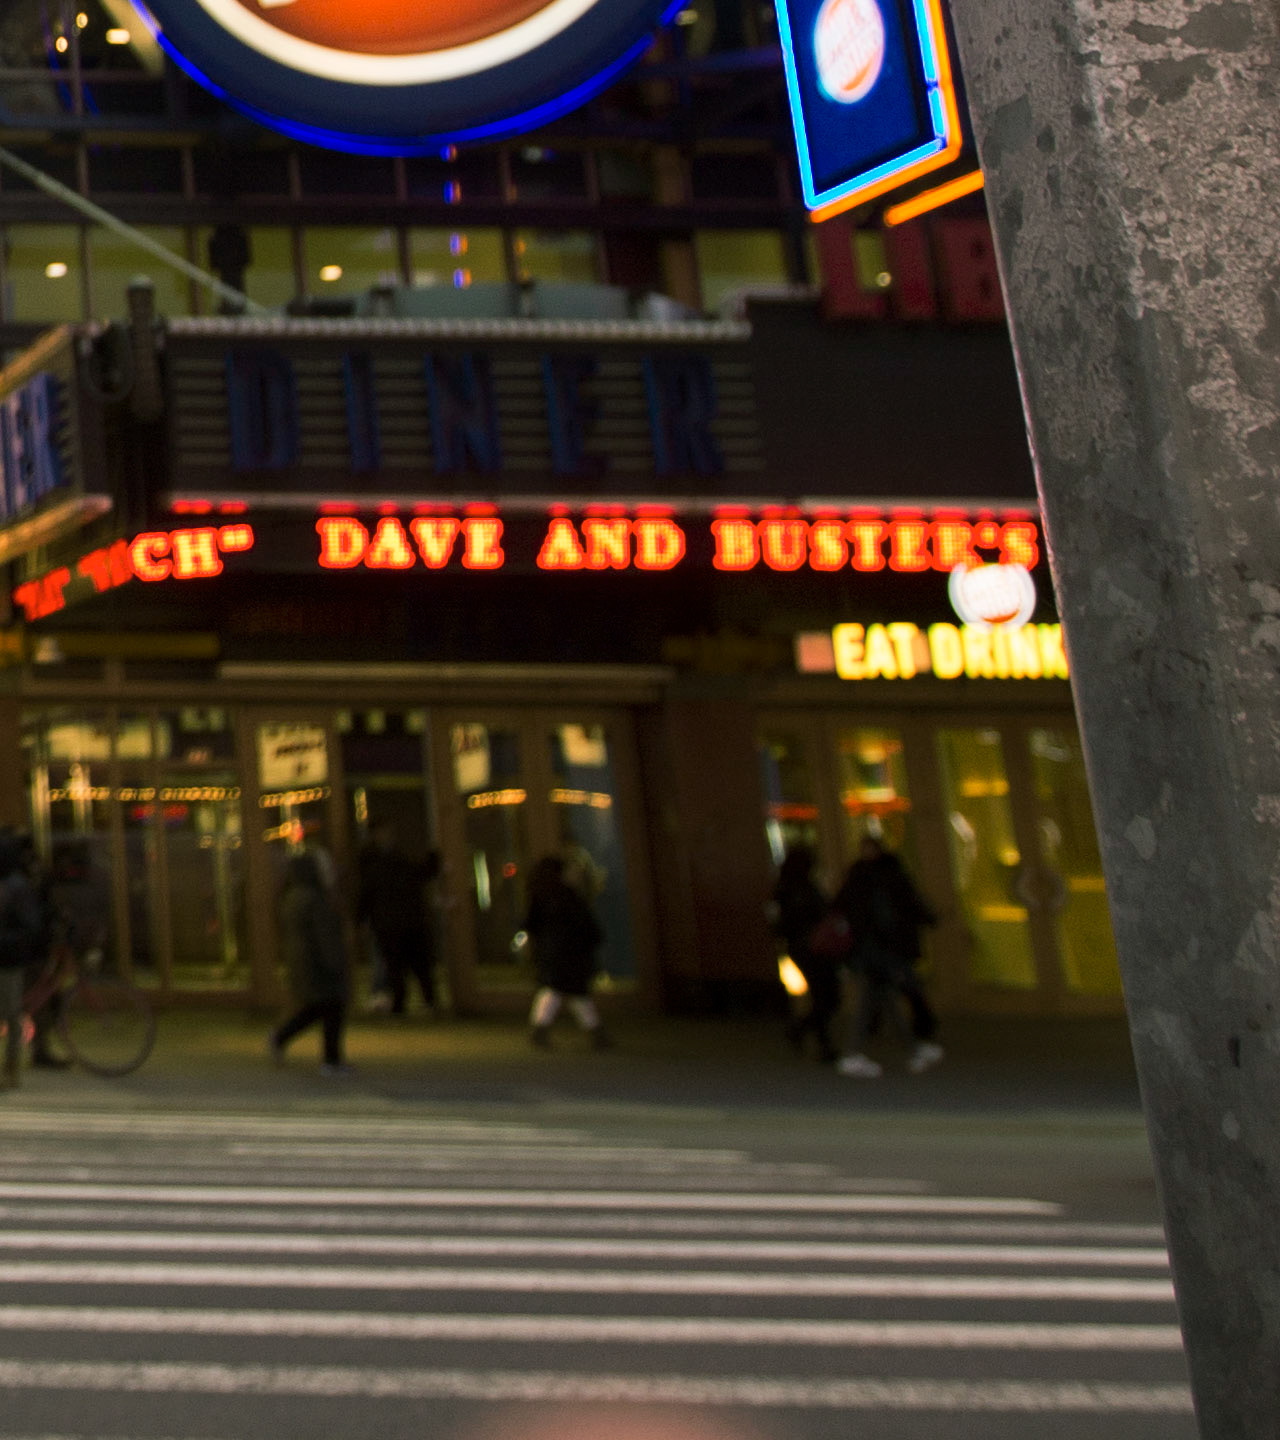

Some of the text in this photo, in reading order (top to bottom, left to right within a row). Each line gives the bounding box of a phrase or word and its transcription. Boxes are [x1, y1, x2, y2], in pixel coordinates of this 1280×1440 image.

[226, 348, 725, 476] DINER
[317, 518, 504, 570] DAVE
[537, 518, 686, 570] AND
[710, 519, 1040, 573] BUSTER'S
[832, 621, 1071, 680] EAT DRINK
